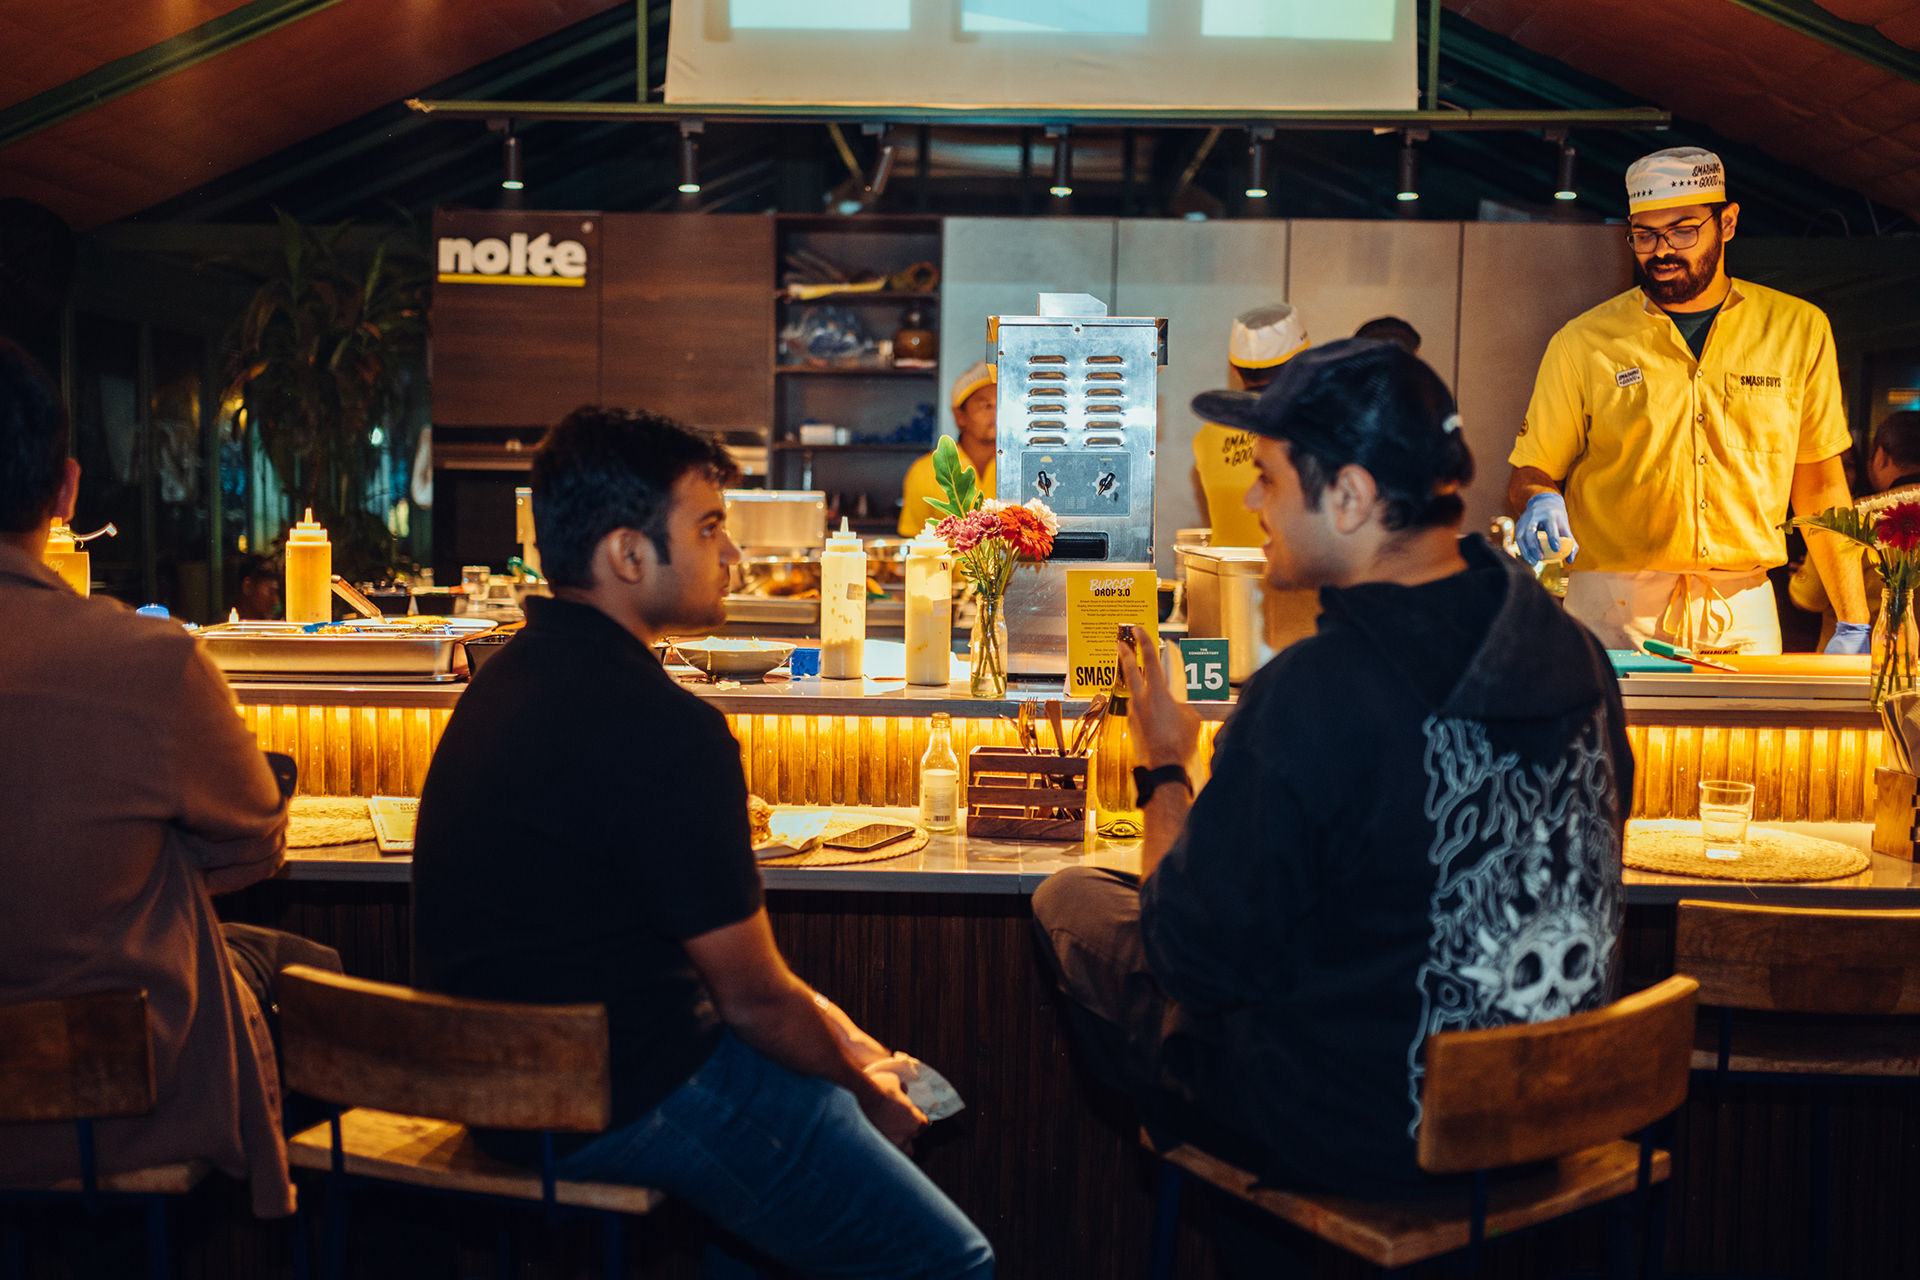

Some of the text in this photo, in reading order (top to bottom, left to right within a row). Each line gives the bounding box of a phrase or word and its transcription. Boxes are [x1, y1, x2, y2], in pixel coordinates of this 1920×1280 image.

[438, 232, 587, 278] nolte
[1740, 375, 1781, 388] SMASH GUYS
[1090, 577, 1134, 591] BURGER
[1095, 588, 1130, 597] DROP 3.0
[1185, 663, 1224, 690] 15
